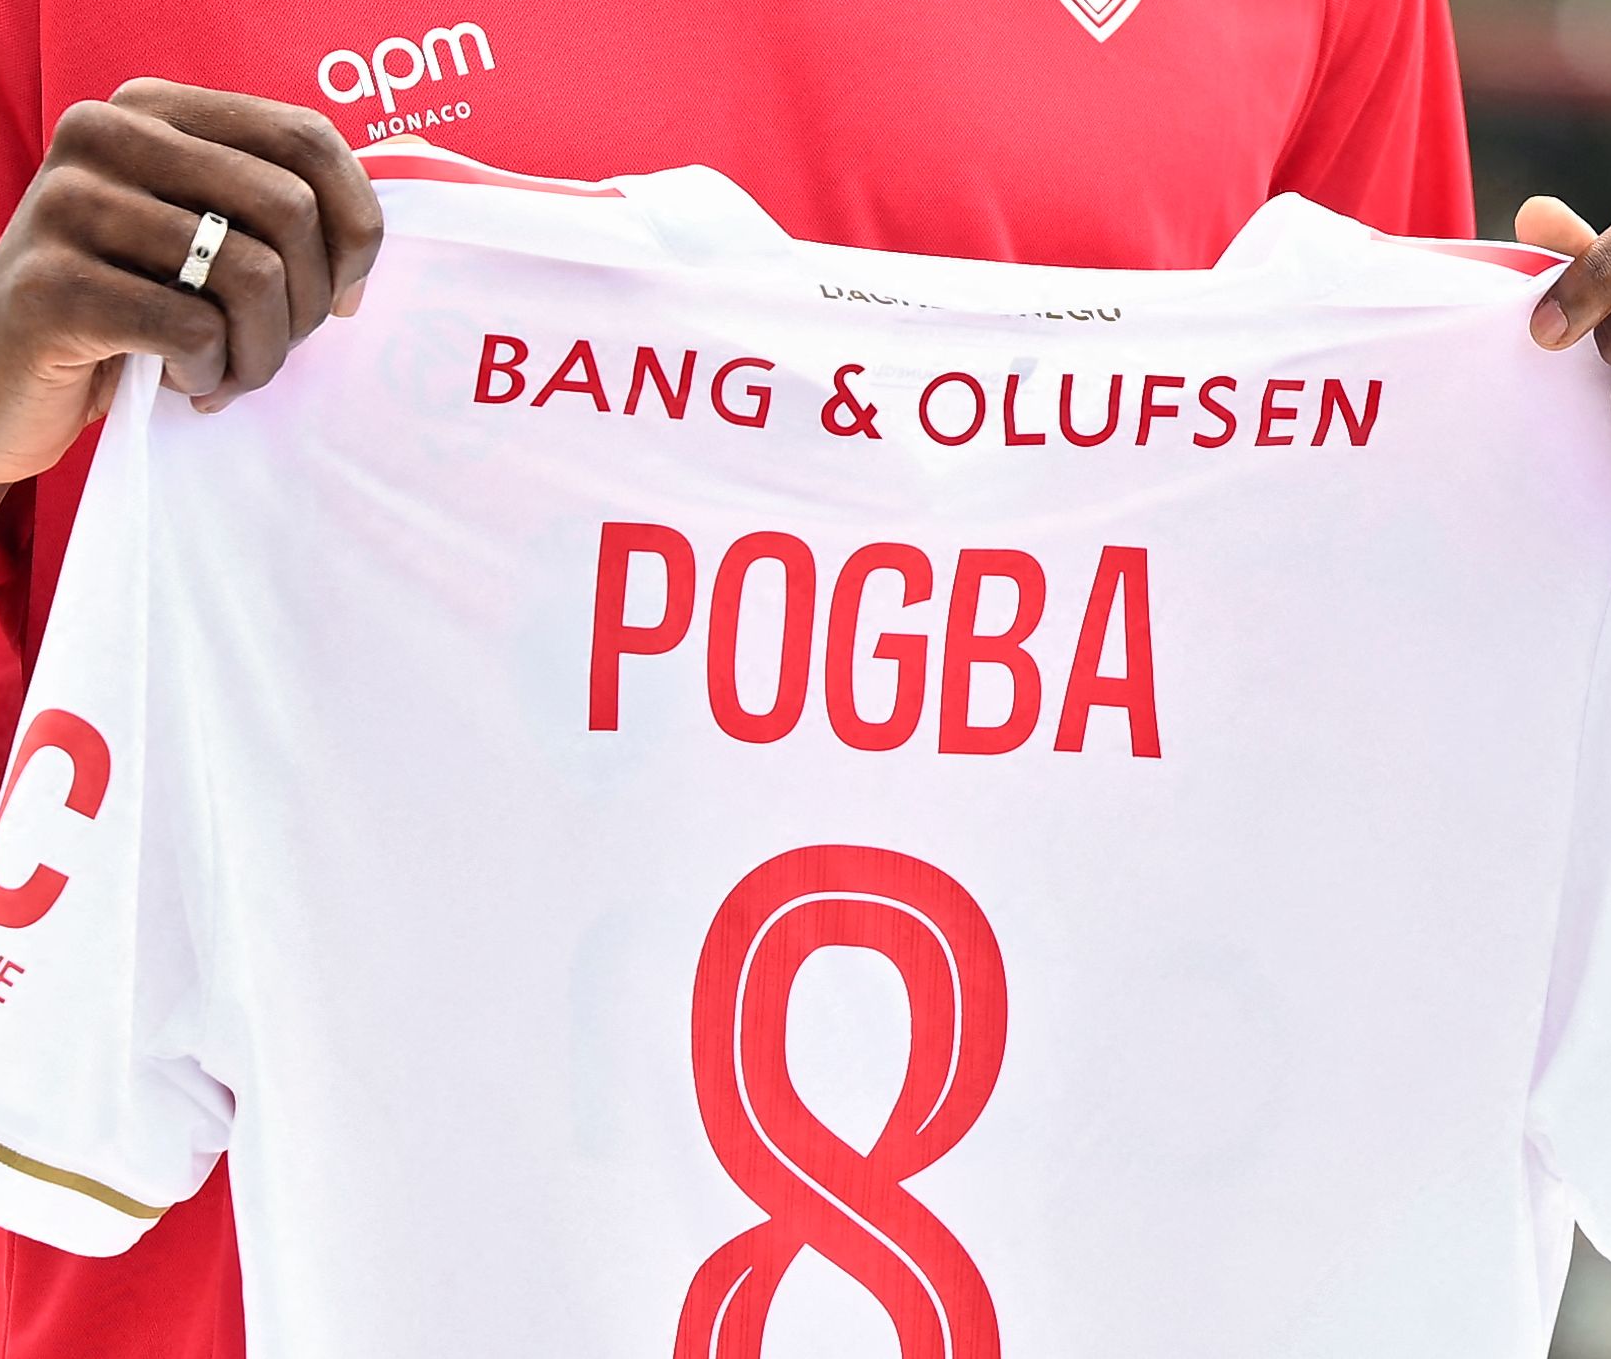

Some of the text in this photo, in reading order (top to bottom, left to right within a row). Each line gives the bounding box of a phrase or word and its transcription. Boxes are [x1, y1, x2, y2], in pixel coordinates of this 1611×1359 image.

[317, 21, 496, 114] apm
[366, 100, 472, 141] MONACO
[473, 333, 775, 429] BANG
[820, 363, 883, 440] &
[918, 371, 1383, 449] OLUFSEN
[588, 521, 1162, 759] POGBA
[672, 844, 1009, 1359] 8
